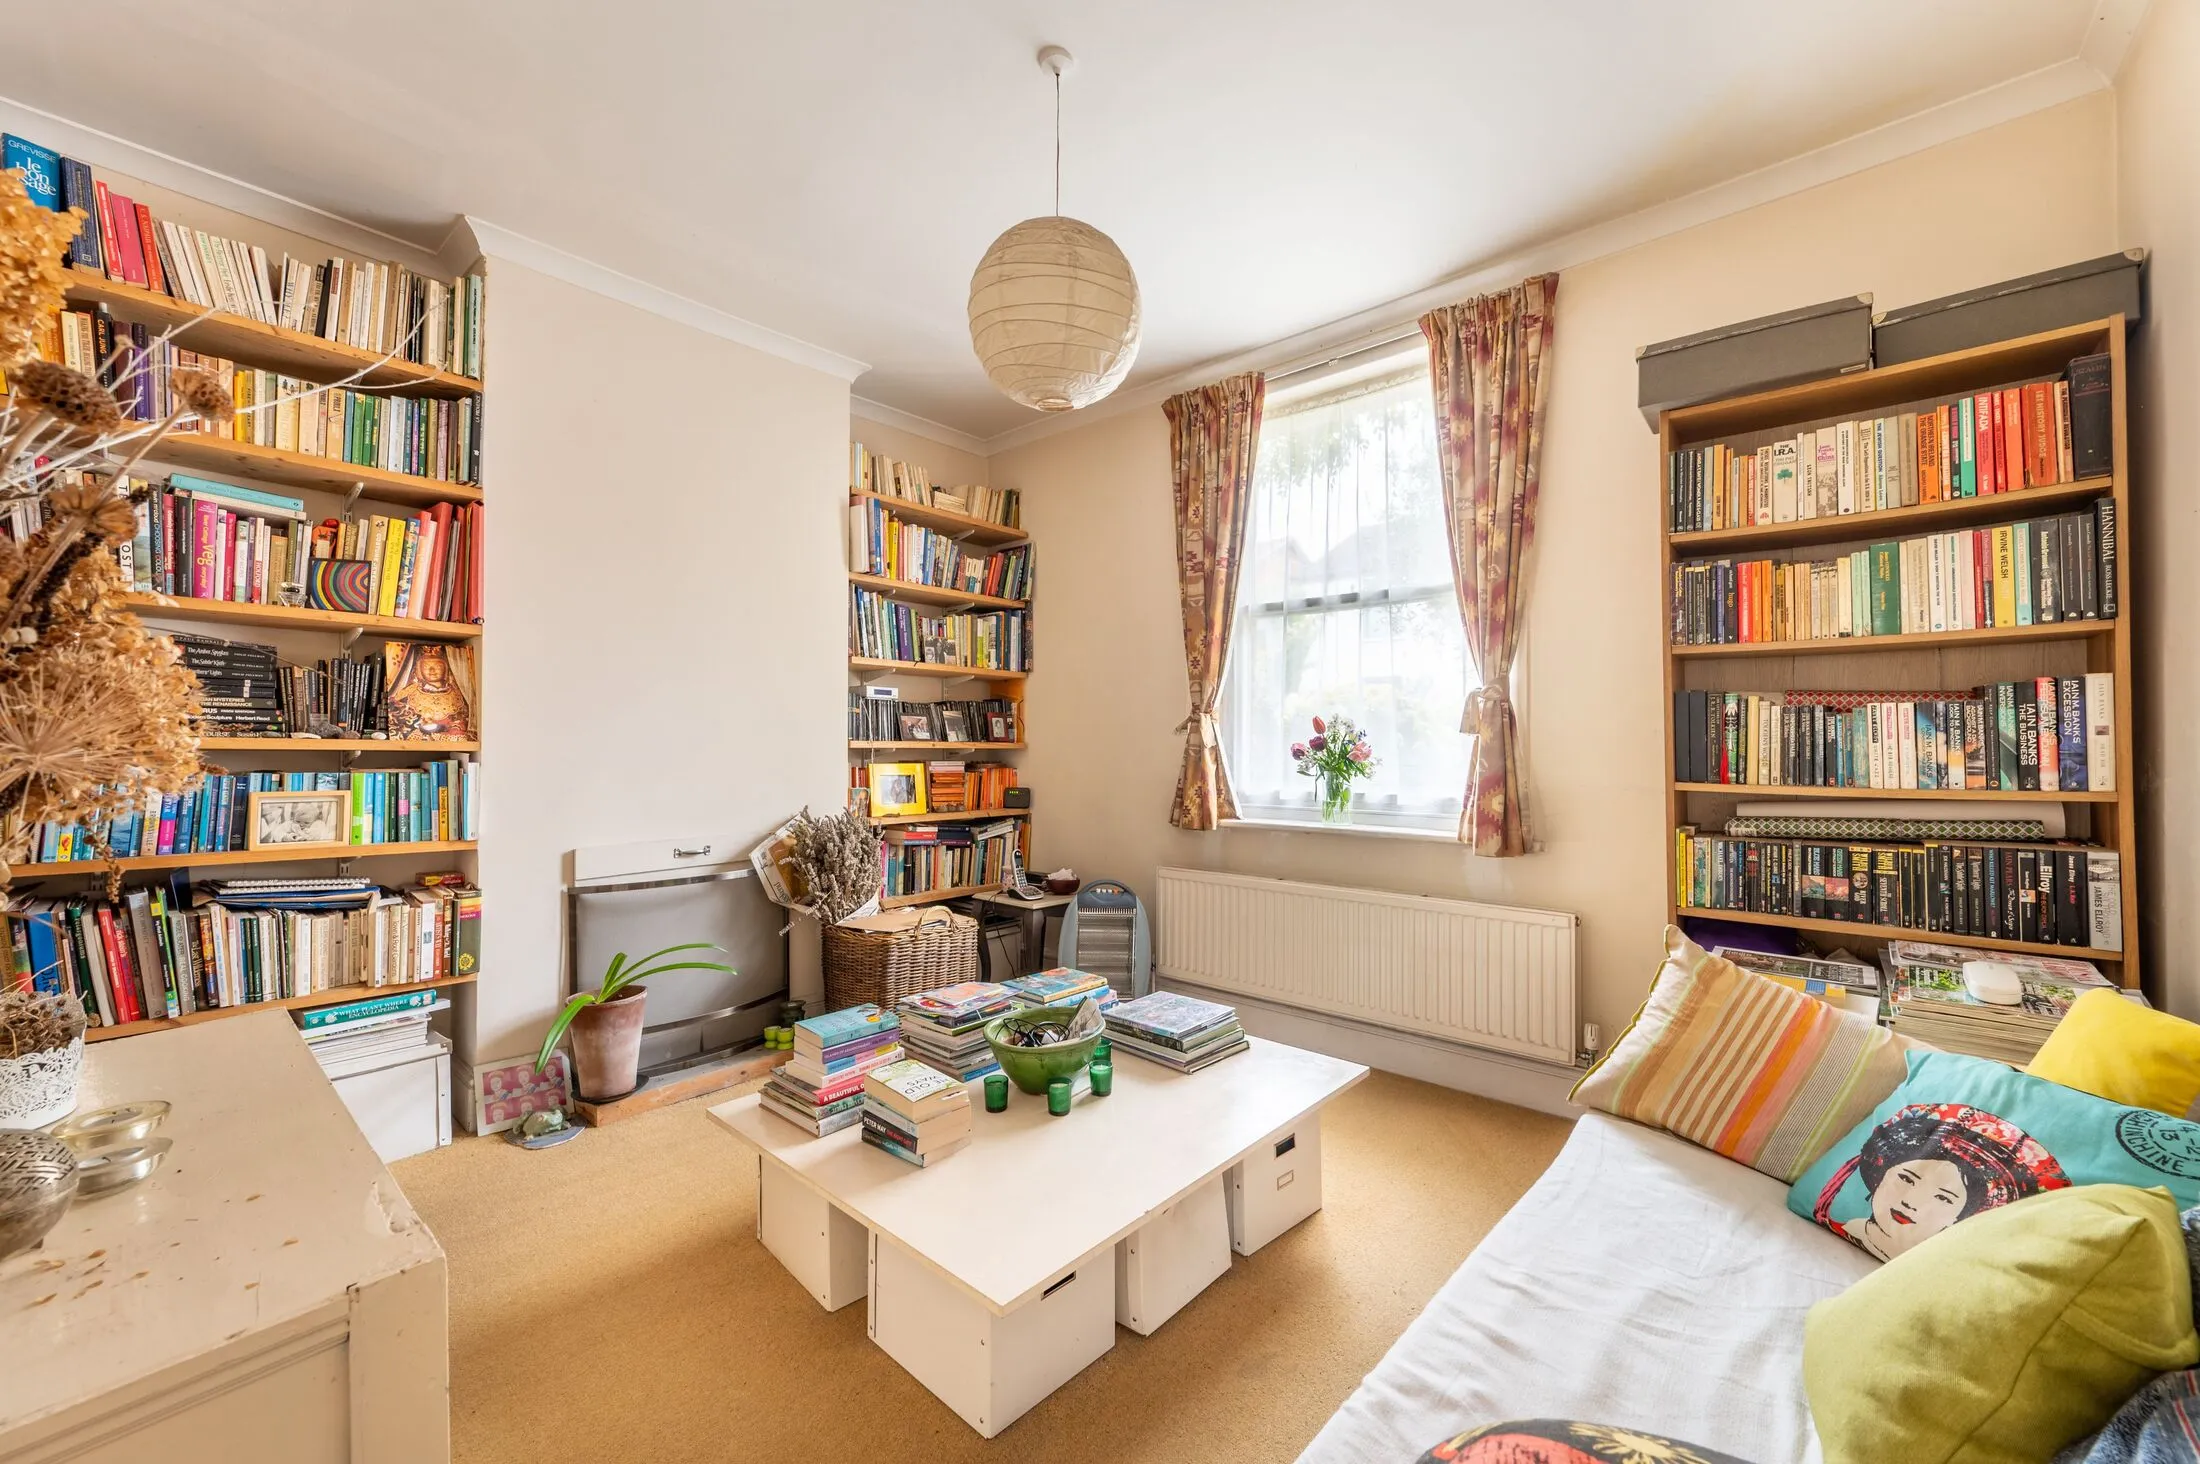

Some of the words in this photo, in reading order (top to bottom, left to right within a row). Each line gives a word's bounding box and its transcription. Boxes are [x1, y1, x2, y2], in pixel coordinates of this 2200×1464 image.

[8, 139, 56, 163] GREVISSE
[27, 157, 41, 172] le
[97, 319, 106, 334] CARL
[99, 334, 107, 354] JUNG
[2035, 390, 2045, 402] LET
[1978, 396, 1989, 432] INTIFADA
[2035, 403, 2046, 432] HISTORY
[1920, 427, 1928, 449] ORANGE
[1926, 415, 1936, 443] NORTHERN
[2063, 423, 2071, 450] REVOLUTION
[1928, 444, 1936, 467] IRELAND
[2037, 434, 2047, 458] JUDGE
[1920, 449, 1928, 466] STATE
[154, 523, 162, 553] CHOOSING
[202, 526, 211, 543] Cottage
[2000, 530, 2008, 553] IRVINE
[2101, 505, 2115, 563] HANNIBAL
[197, 543, 215, 567] veg
[255, 561, 263, 588] HOLFORD
[2000, 554, 2008, 579] WELSH
[2105, 579, 2113, 599] LECKIE
[1726, 592, 1736, 608] hugo
[2006, 685, 2014, 699] IAIN
[2047, 682, 2056, 701] IAIN
[2071, 680, 2079, 699] IAIN
[1976, 704, 1984, 718] IAIN
[1999, 685, 2007, 727] INVERSIONS
[2018, 703, 2027, 721] THE
[2026, 703, 2036, 725] IAIN
[2048, 701, 2056, 711] M.
[2062, 680, 2073, 735] EXCESSION
[2072, 699, 2080, 709] M.
[1924, 724, 1932, 741] IAIN
[1949, 719, 1955, 727] TO
[1953, 720, 1961, 729] M.
[1965, 705, 1973, 743] BACKGROUND
[2007, 708, 2015, 738] BANKS
[2048, 711, 2057, 746] BANKS
[2072, 709, 2081, 744] BANKS
[1925, 741, 1932, 749] M.
[1954, 729, 1962, 756] BANKS
[1977, 724, 1985, 748] BANKS
[2019, 722, 2028, 766] BUSINESS
[2028, 730, 2038, 766] BANKS
[1925, 751, 1934, 778] BANKS
[1813, 861, 1821, 876] MARS
[1852, 853, 1861, 871] SMITH
[1877, 852, 1886, 870] SMITH
[2005, 852, 2013, 866] IAIN
[2038, 852, 2046, 866] James
[2005, 866, 2014, 886] PEARS
[2038, 865, 2053, 894] Ellroy
[2068, 869, 2077, 883] Ellroy
[1879, 877, 1888, 897] SEVENTH
[2093, 886, 2103, 908] JAMES
[1859, 890, 1867, 905] RIVER
[1879, 897, 1888, 912] SCROLL
[175, 919, 183, 934] NIGEL
[2094, 909, 2104, 934] ELLROY
[74, 917, 86, 960] Pelargoniums
[116, 929, 124, 940] rick
[177, 935, 185, 955] SLATER
[191, 947, 201, 960] Last
[179, 956, 187, 972] REAL
[192, 959, 203, 987] Wilderness
[391, 953, 399, 977] Gardens
[181, 973, 190, 1001] COOKING
[338, 1007, 360, 1016] WHAT
[361, 1003, 384, 1012] PLANT
[384, 998, 408, 1008] WHERE
[348, 1005, 400, 1019] ENCYCLOPEDIA
[904, 1083, 930, 1095] OLD
[906, 1074, 937, 1087] WAYS
[823, 1095, 829, 1103] A
[829, 1086, 859, 1100] BEAUTIFUL
[863, 1116, 878, 1130] PETER
[877, 1123, 887, 1134] MAY
